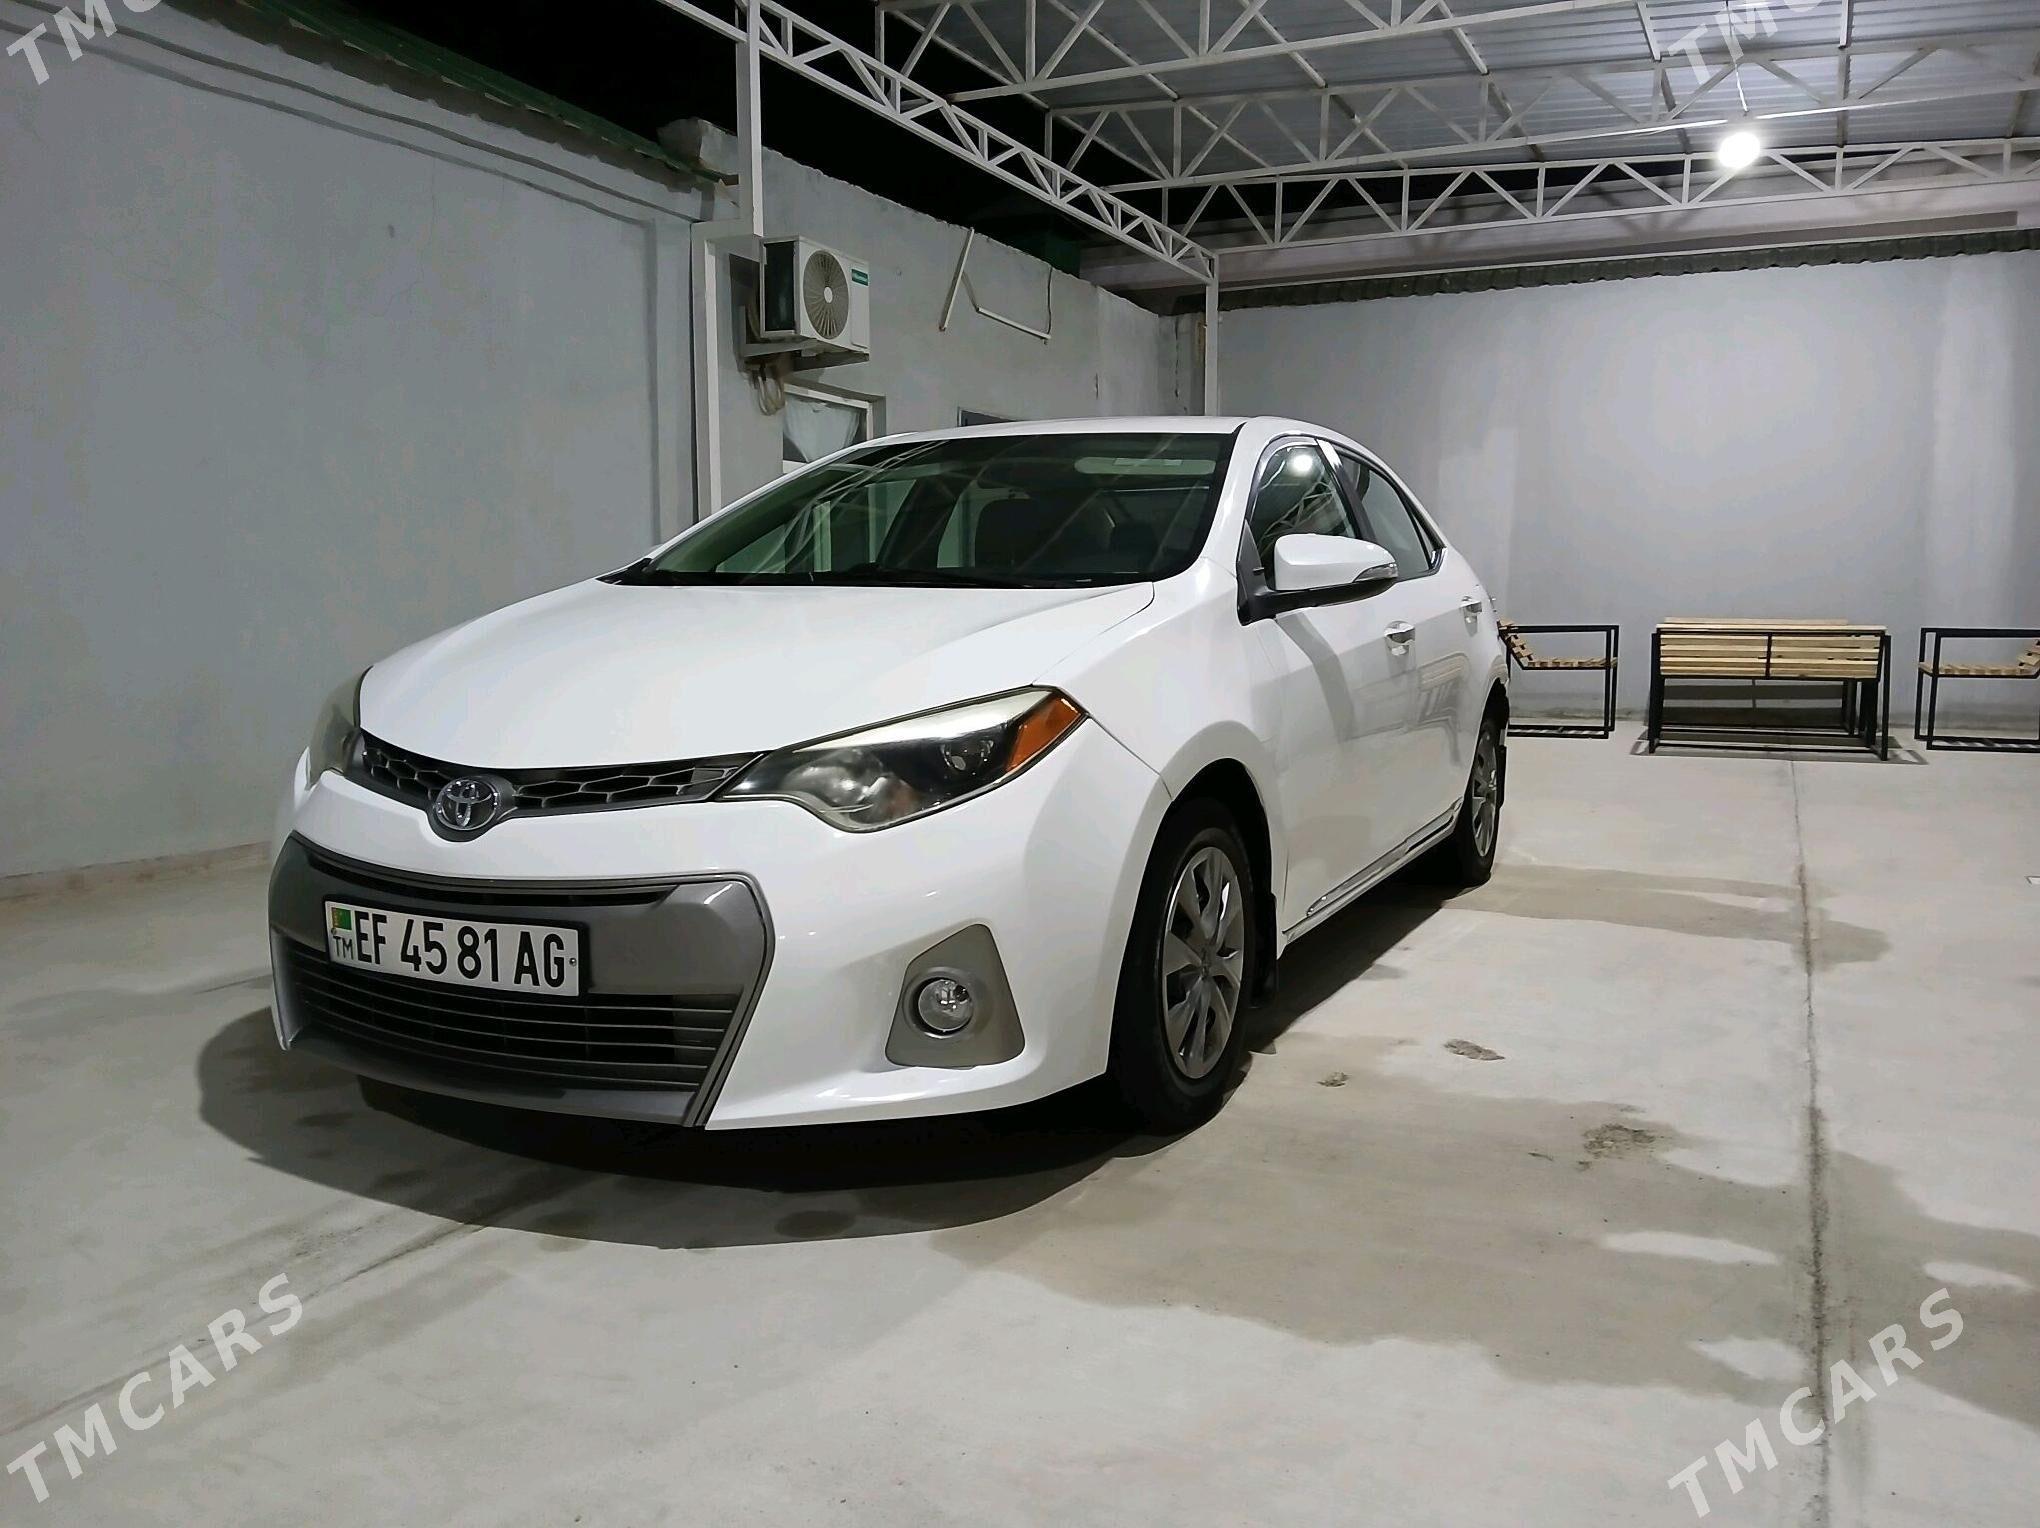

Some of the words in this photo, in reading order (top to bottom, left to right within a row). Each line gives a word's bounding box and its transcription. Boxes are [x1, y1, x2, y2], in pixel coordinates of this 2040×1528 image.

[332, 935, 354, 961] TM
[354, 910, 388, 965] EF
[513, 930, 565, 988] AG
